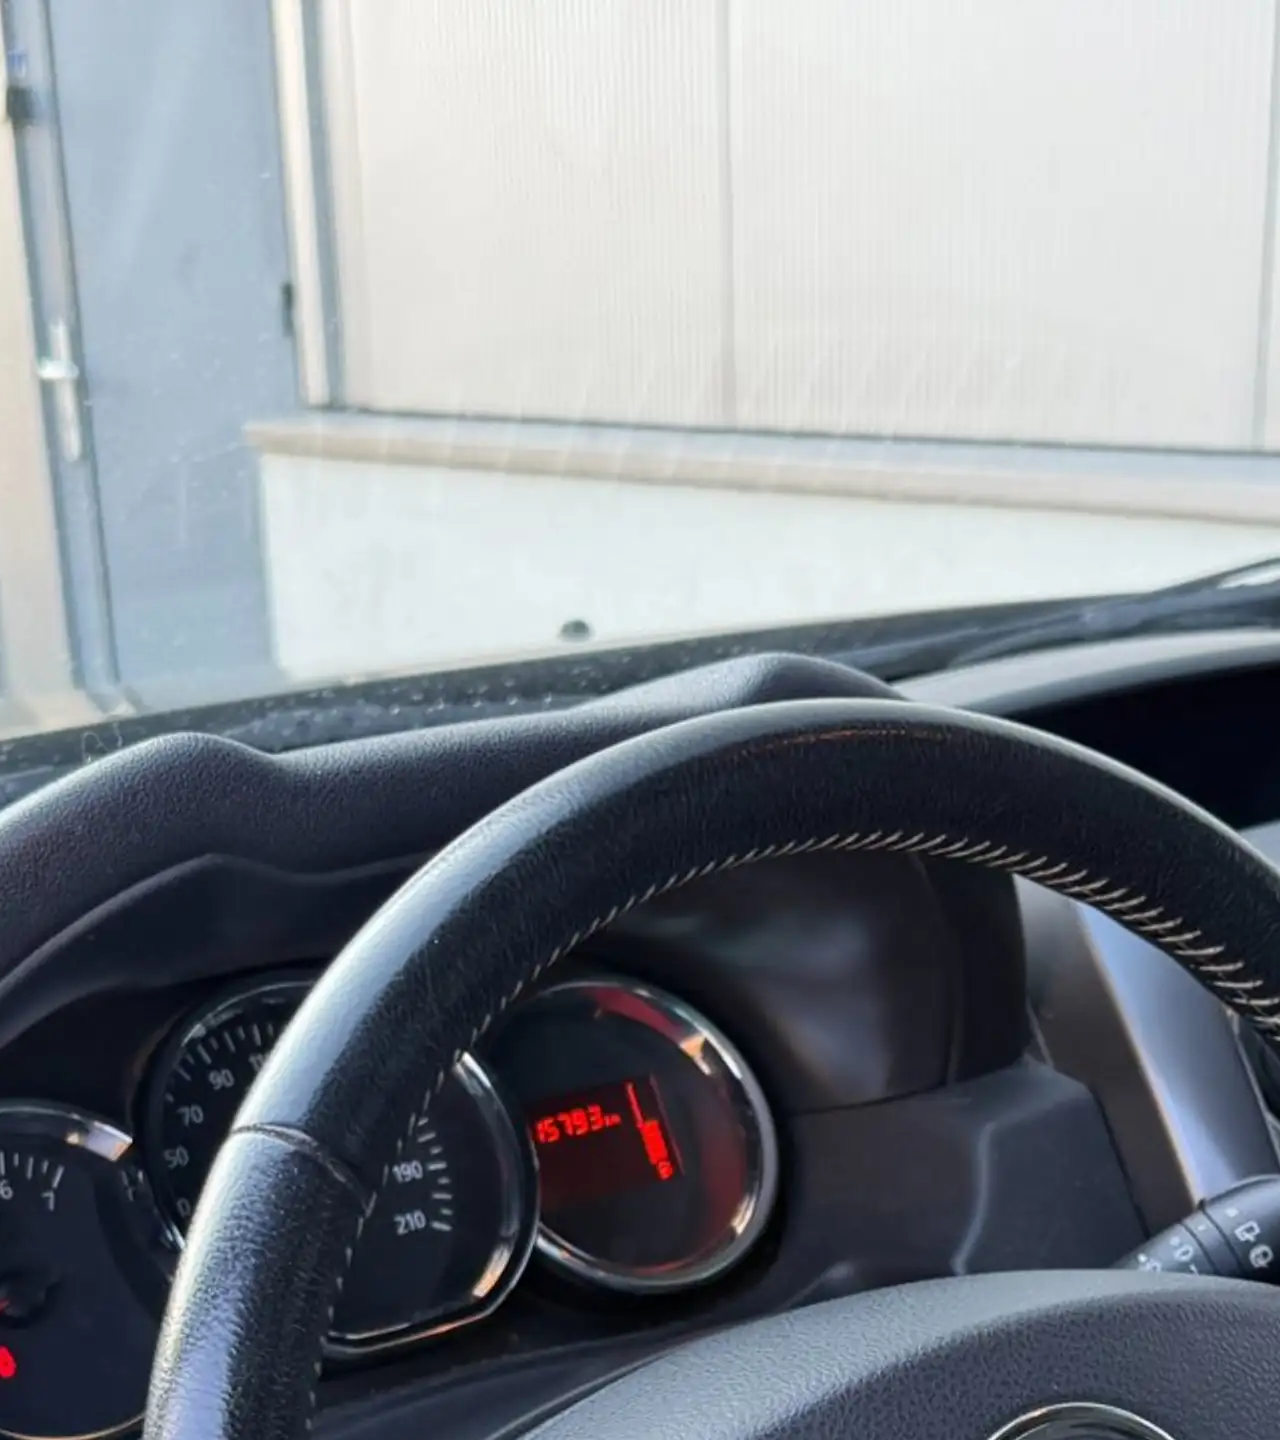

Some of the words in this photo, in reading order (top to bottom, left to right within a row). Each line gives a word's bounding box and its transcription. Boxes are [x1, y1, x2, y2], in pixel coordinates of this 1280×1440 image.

[208, 1068, 235, 1091] 90
[177, 1104, 204, 1127] 70
[535, 1104, 603, 1143] 15793
[163, 1146, 189, 1169] 50
[392, 1160, 423, 1183] 190
[41, 1190, 55, 1211] 7
[177, 1198, 192, 1218] 0
[394, 1210, 427, 1235] 210
